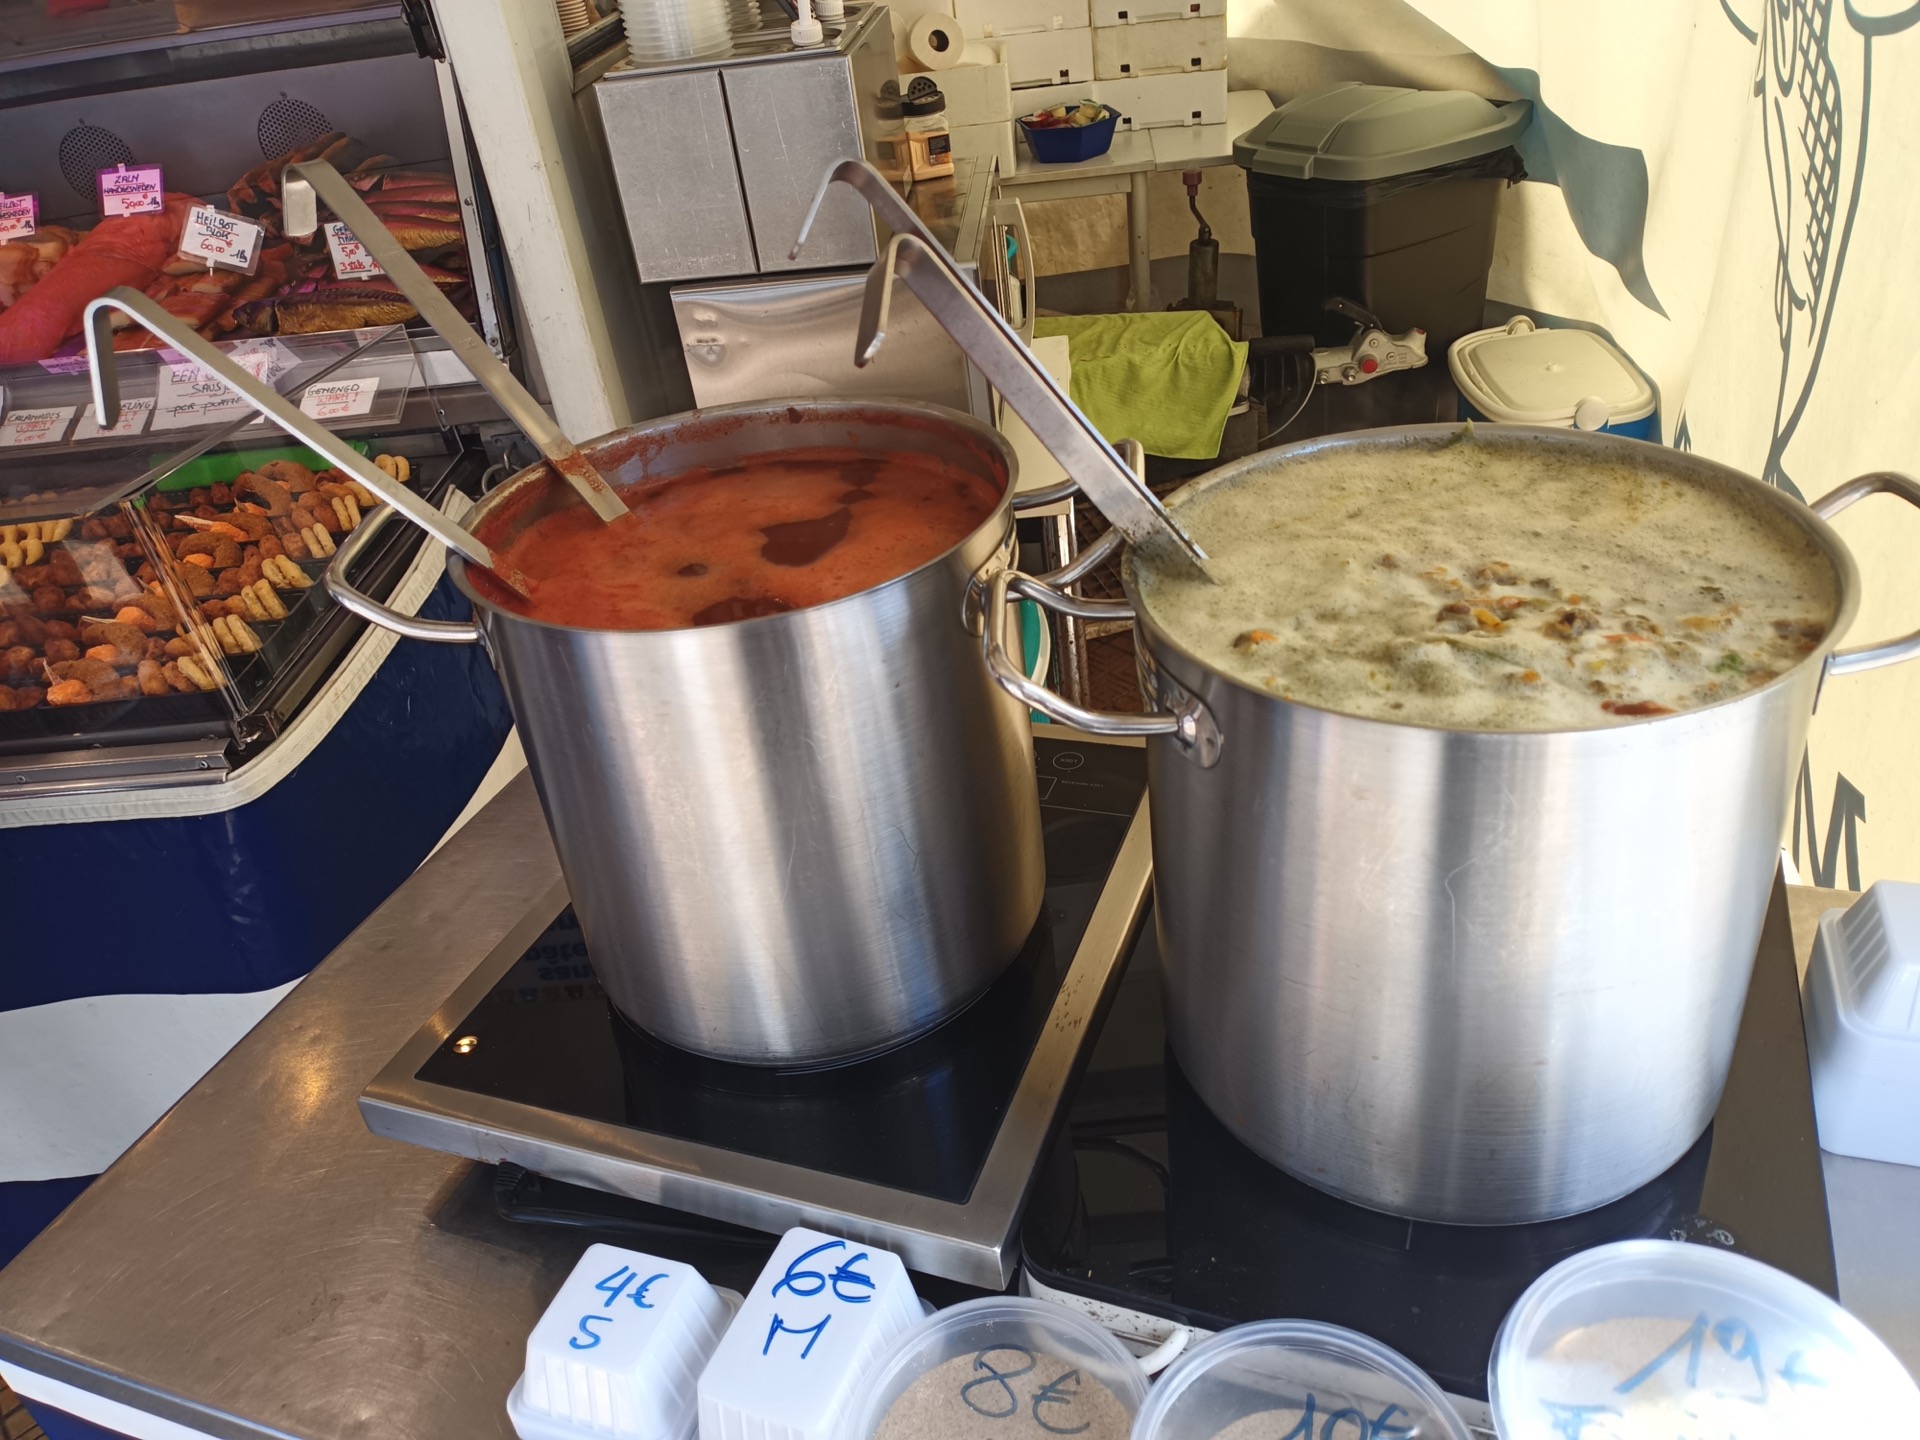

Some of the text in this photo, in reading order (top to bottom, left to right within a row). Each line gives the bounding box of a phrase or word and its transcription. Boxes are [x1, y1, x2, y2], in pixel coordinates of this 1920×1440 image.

[307, 383, 360, 396] GEMENGD
[594, 1265, 670, 1309] 4€
[771, 1240, 877, 1304] 6€
[762, 1312, 832, 1360] M
[959, 1342, 1091, 1435] 8€
